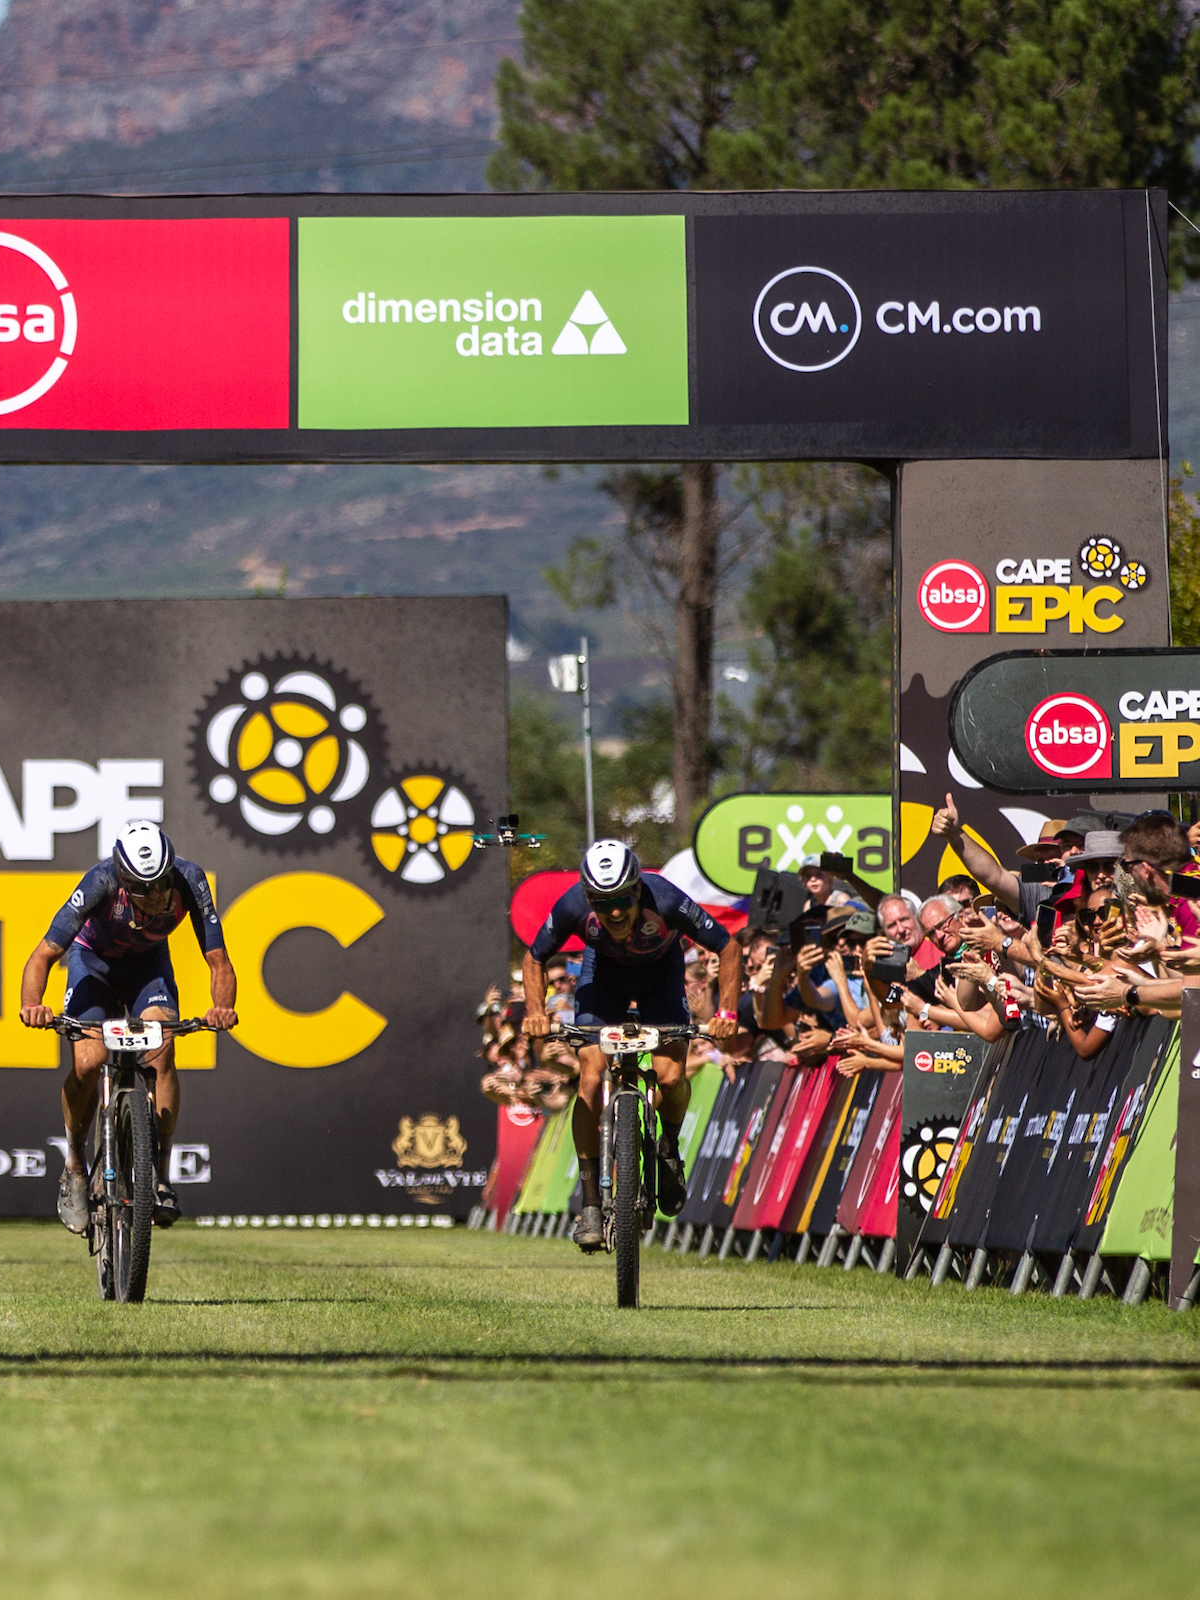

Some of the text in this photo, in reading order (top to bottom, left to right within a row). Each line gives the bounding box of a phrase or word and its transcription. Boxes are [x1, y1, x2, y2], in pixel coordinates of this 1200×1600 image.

[341, 290, 542, 324] dimension
[875, 300, 1041, 334] CM.com
[455, 325, 543, 357] data
[995, 558, 1071, 584] CAPE
[928, 582, 978, 604] absa
[995, 585, 1125, 633] EPIC
[1038, 719, 1098, 745] absa
[1119, 722, 1200, 778] EP
[117, 1036, 149, 1047] 13-1
[611, 1041, 647, 1051] 13-2
[933, 1058, 966, 1074] EPIC
